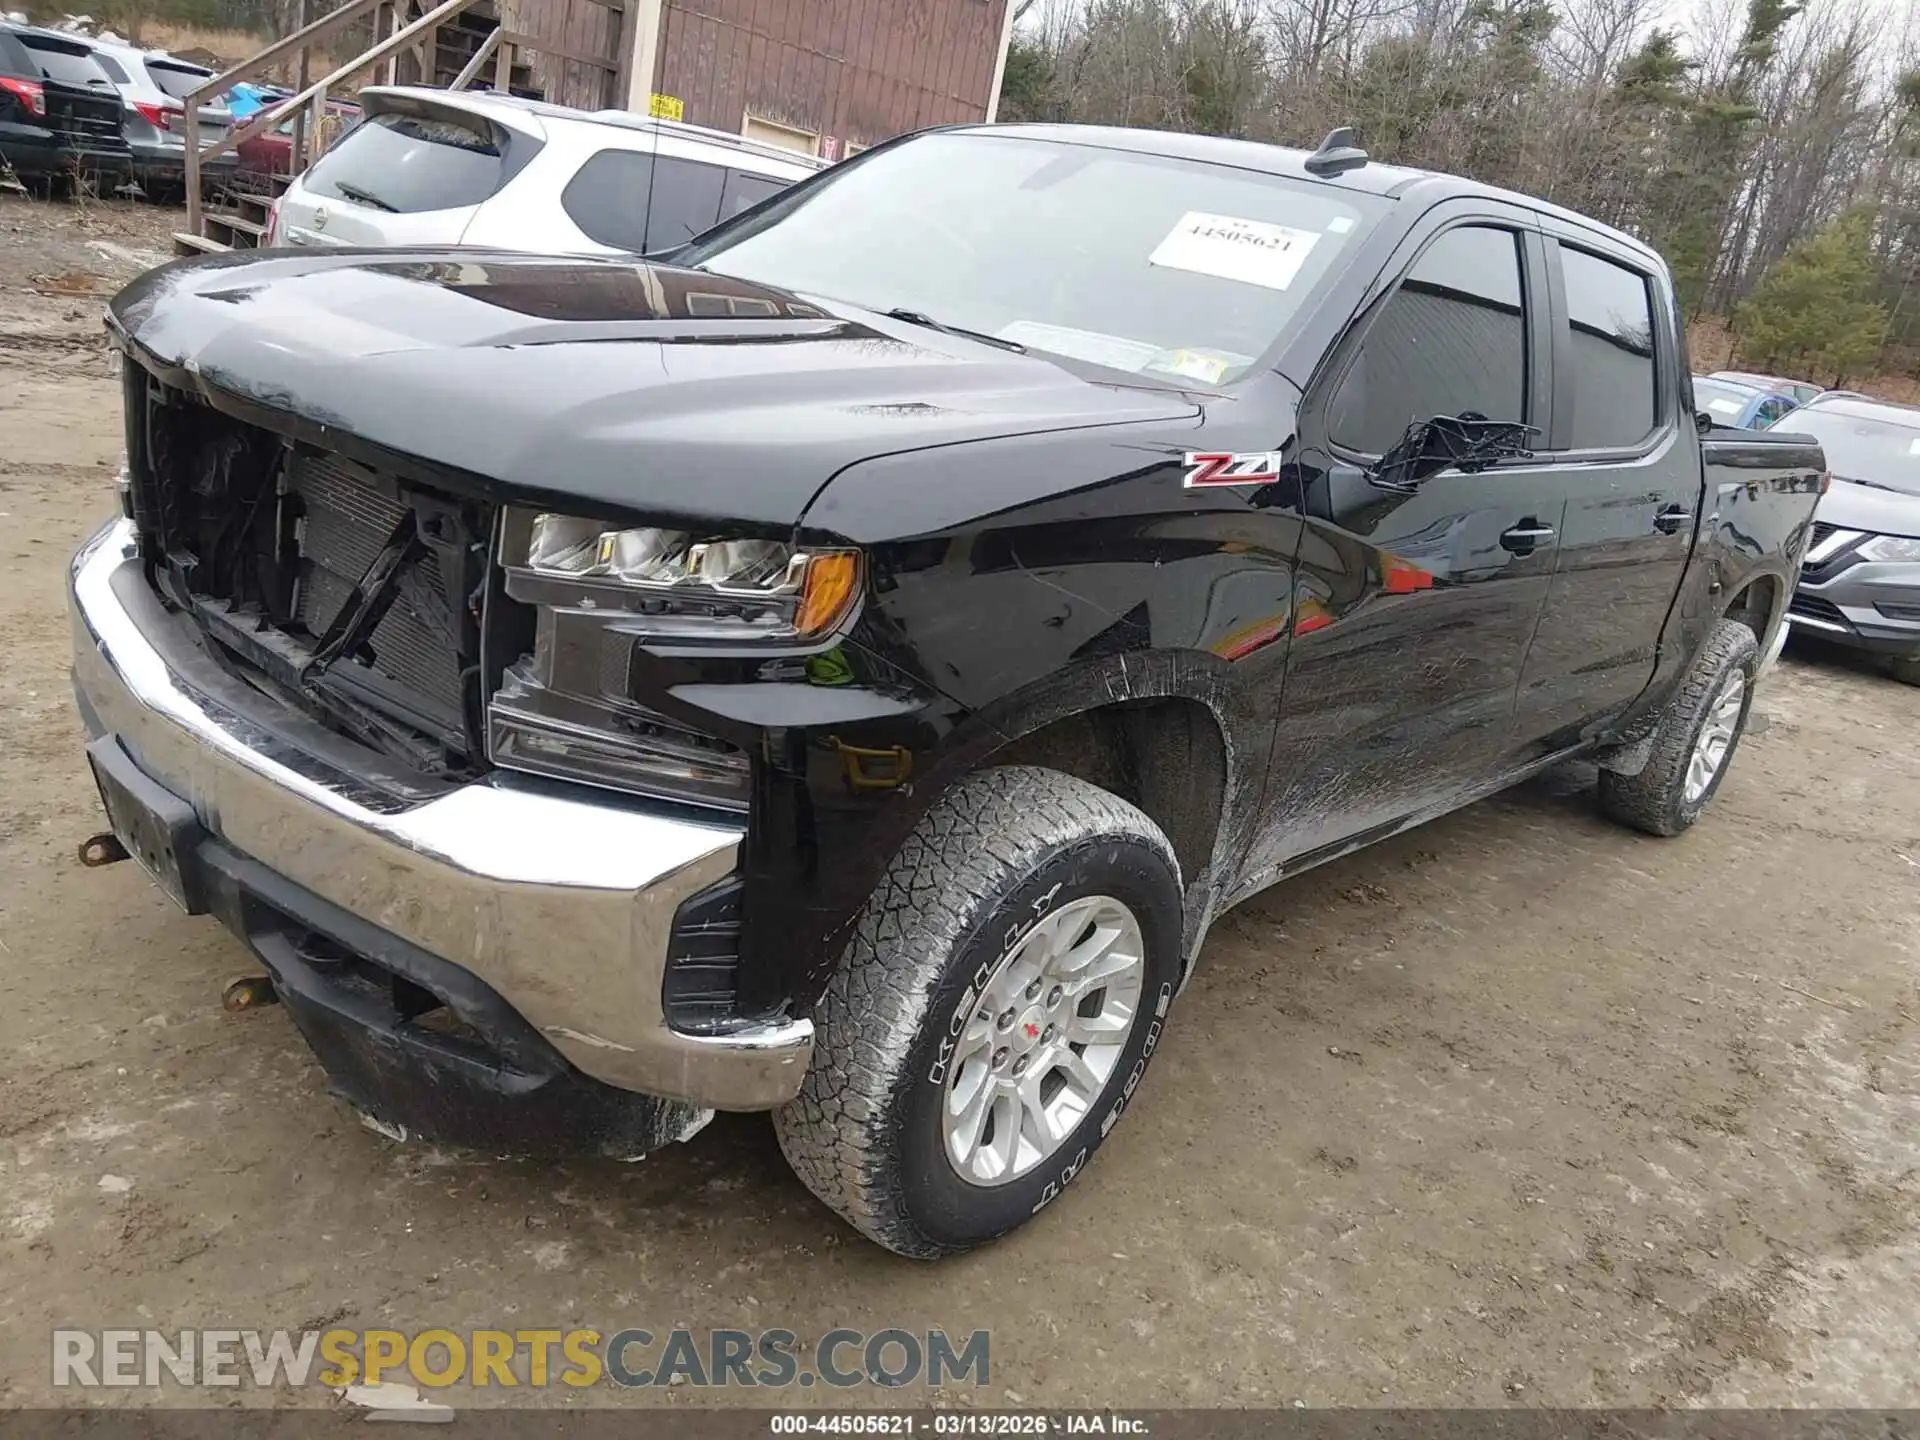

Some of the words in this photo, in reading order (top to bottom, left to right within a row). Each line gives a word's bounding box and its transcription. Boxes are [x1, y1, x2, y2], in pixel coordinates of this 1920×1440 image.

[1183, 451, 1282, 488] Z71
[928, 882, 1063, 1085] KELLY
[1101, 982, 1173, 1139] EDGE
[1032, 1147, 1087, 1214] AT
